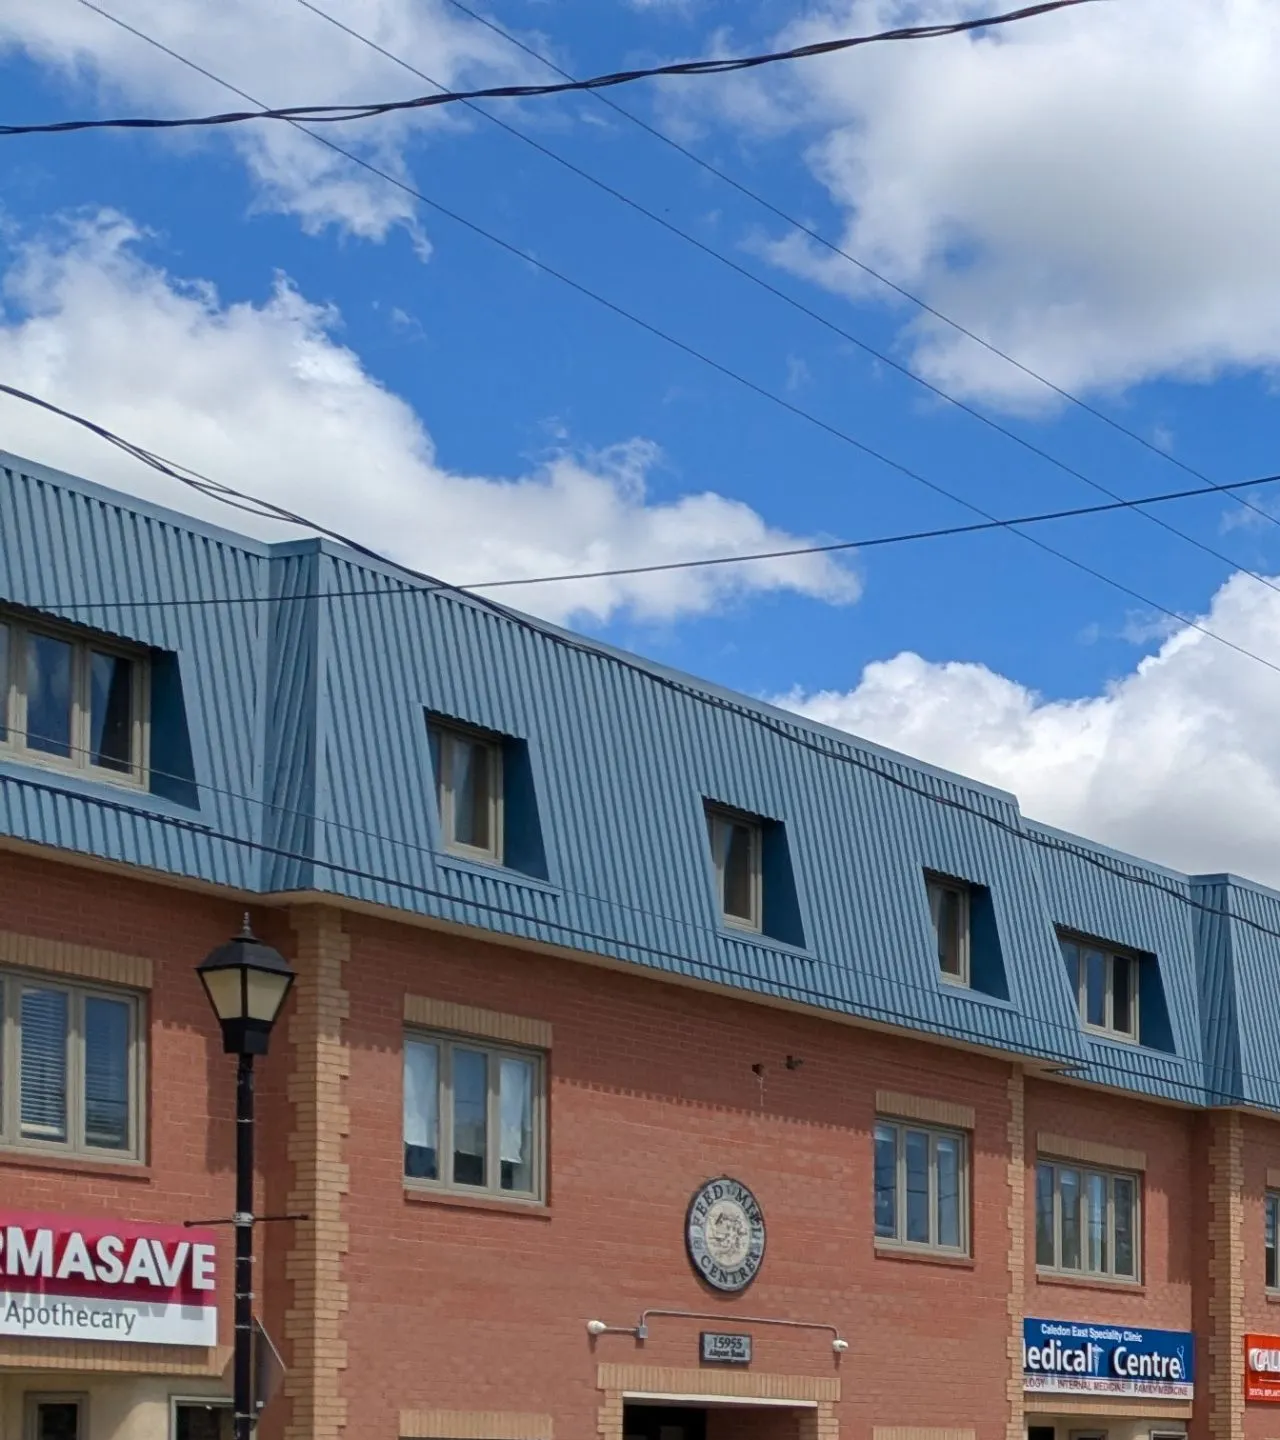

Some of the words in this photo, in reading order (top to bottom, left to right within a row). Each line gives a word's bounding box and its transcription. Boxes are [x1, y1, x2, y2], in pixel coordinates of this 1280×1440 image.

[692, 1184, 724, 1229] FEED
[0, 1226, 215, 1290] MASAVE
[700, 1255, 758, 1285] CENTRE
[5, 1300, 136, 1335] Apothecary
[1040, 1323, 1071, 1335] Caledon
[1072, 1326, 1088, 1338] East
[1123, 1331, 1143, 1343] Clinic
[712, 1337, 743, 1349] 15955
[1023, 1337, 1092, 1373] edical
[1114, 1346, 1181, 1379] Centre
[1057, 1379, 1091, 1391] INTERNAL
[1093, 1382, 1127, 1393] MEDICINE
[1133, 1383, 1157, 1394] FAMILY
[1157, 1385, 1189, 1396] MEDICINE
